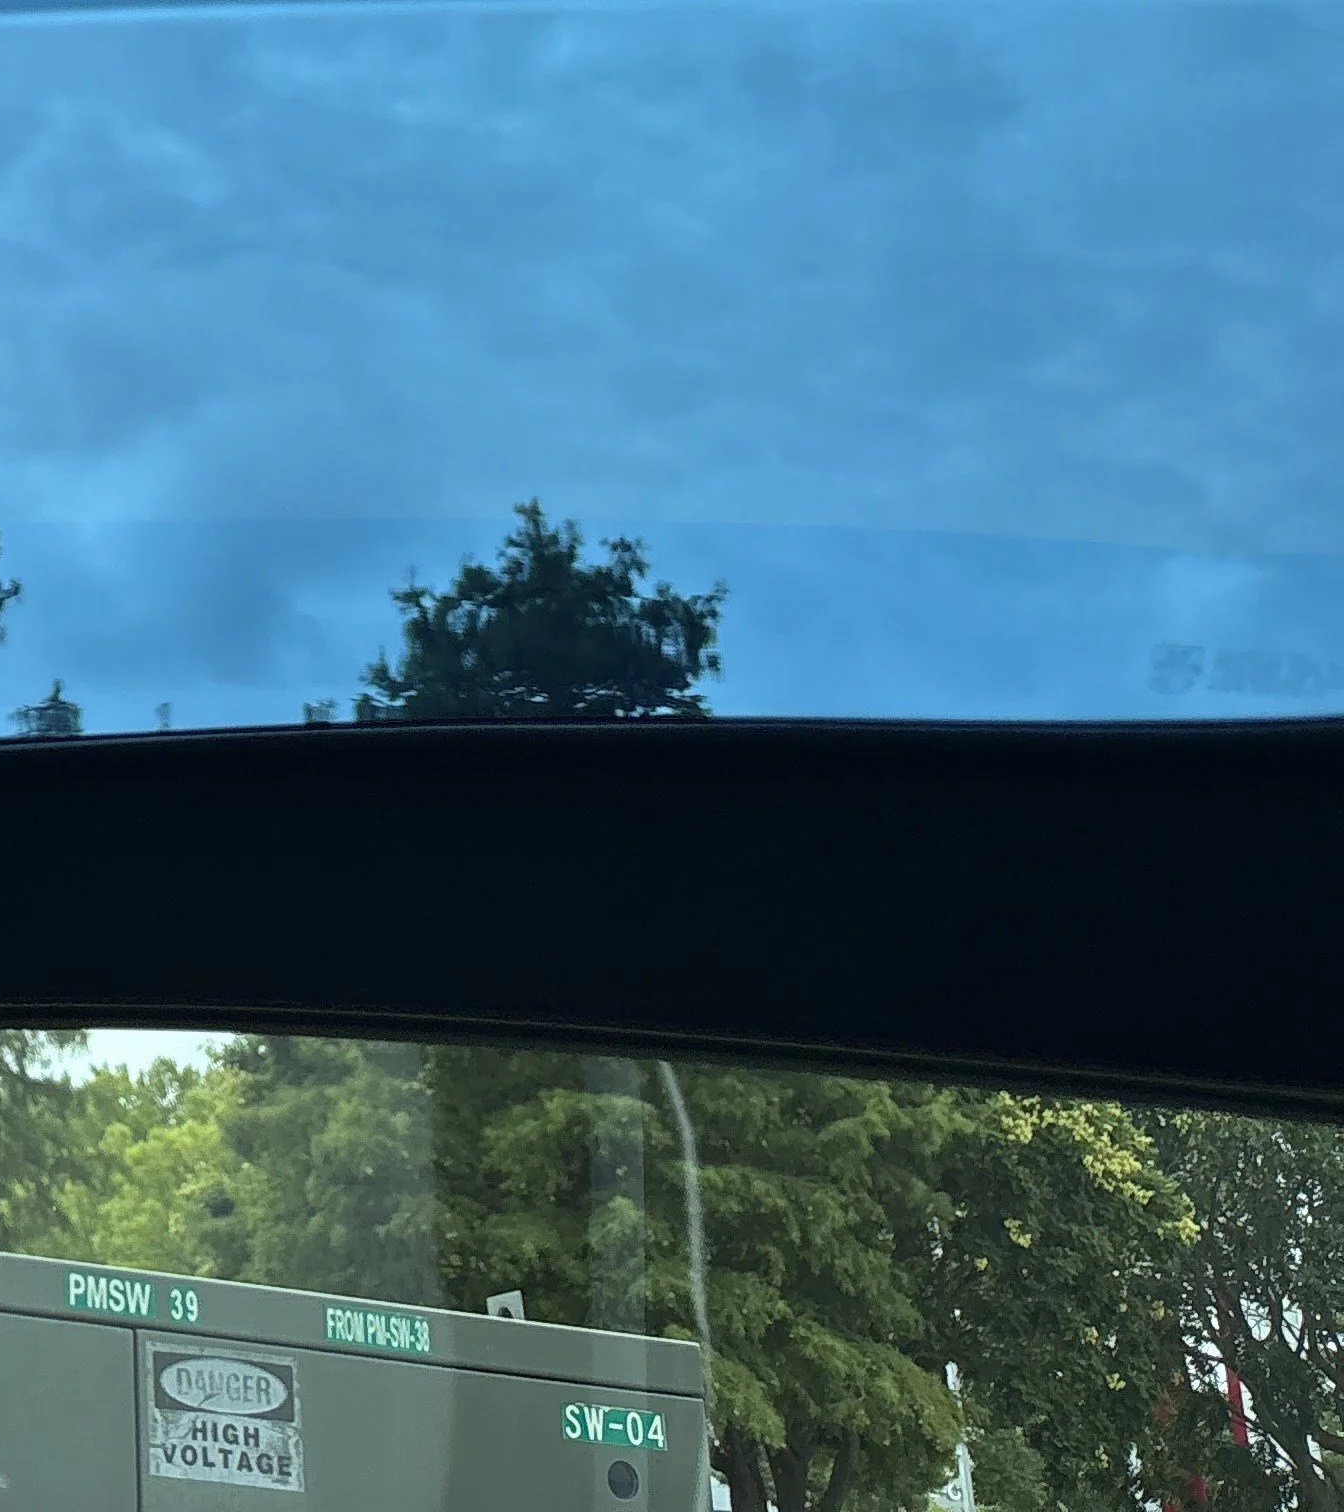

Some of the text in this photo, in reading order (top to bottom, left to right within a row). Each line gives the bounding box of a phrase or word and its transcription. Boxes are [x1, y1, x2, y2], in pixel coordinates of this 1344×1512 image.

[69, 1273, 199, 1323] PMSW 39
[326, 1307, 365, 1343] FROM
[176, 1367, 272, 1405] DANGER
[191, 1419, 261, 1448] HIGH
[565, 1404, 665, 1448] SW-04
[162, 1443, 293, 1477] VOLTAGE
